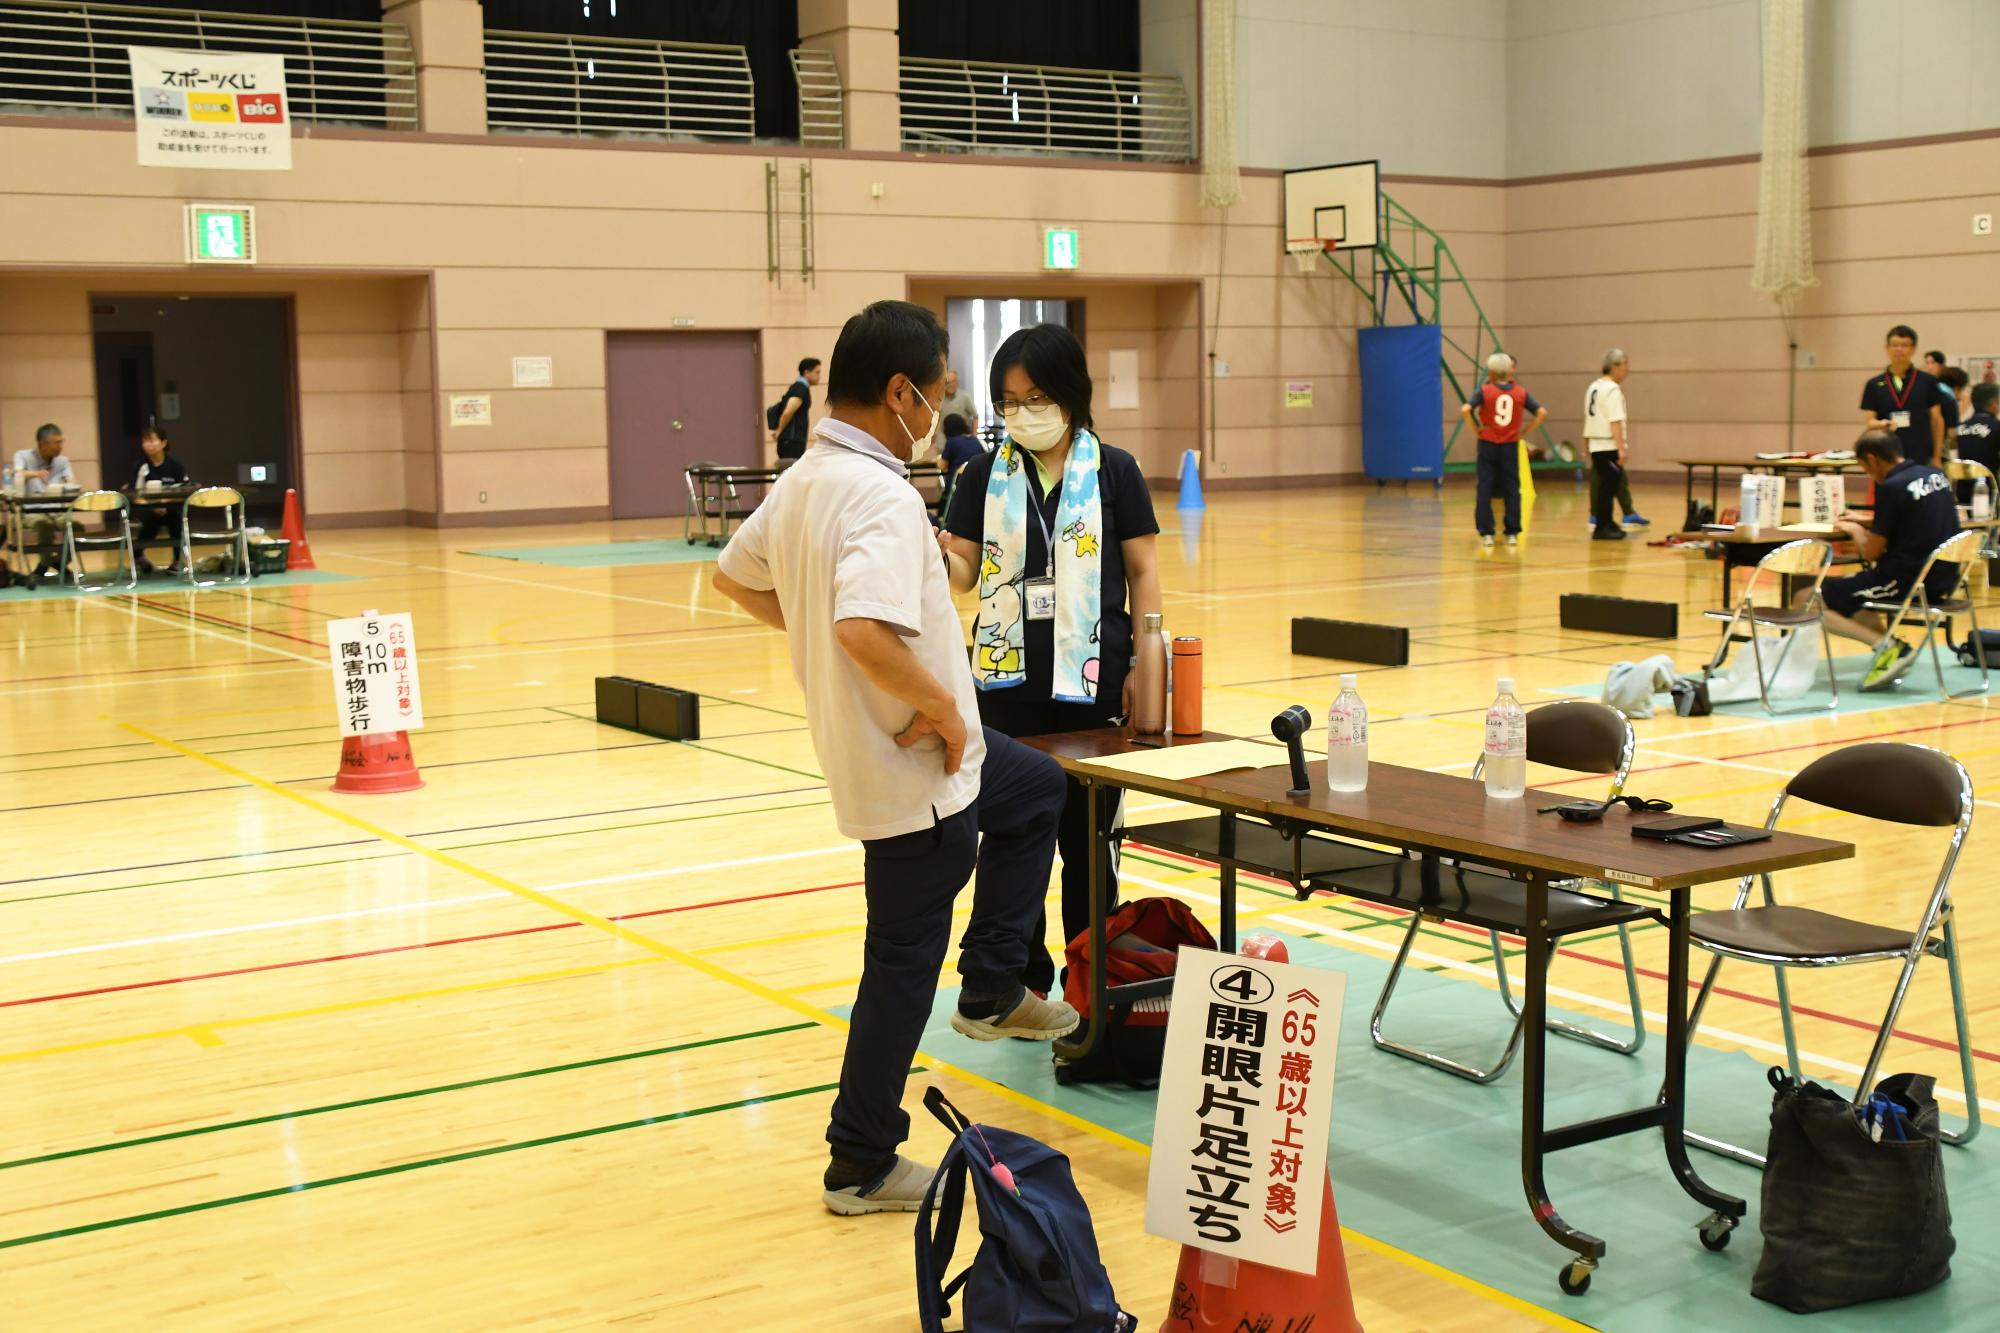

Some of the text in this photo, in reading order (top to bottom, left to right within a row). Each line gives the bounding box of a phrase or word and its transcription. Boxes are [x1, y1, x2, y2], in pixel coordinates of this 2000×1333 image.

[161, 68, 257, 89] スポーツくじ
[1978, 217, 1988, 230] C
[1494, 394, 1514, 426] 9
[341, 641, 371, 731] 障害物歩行
